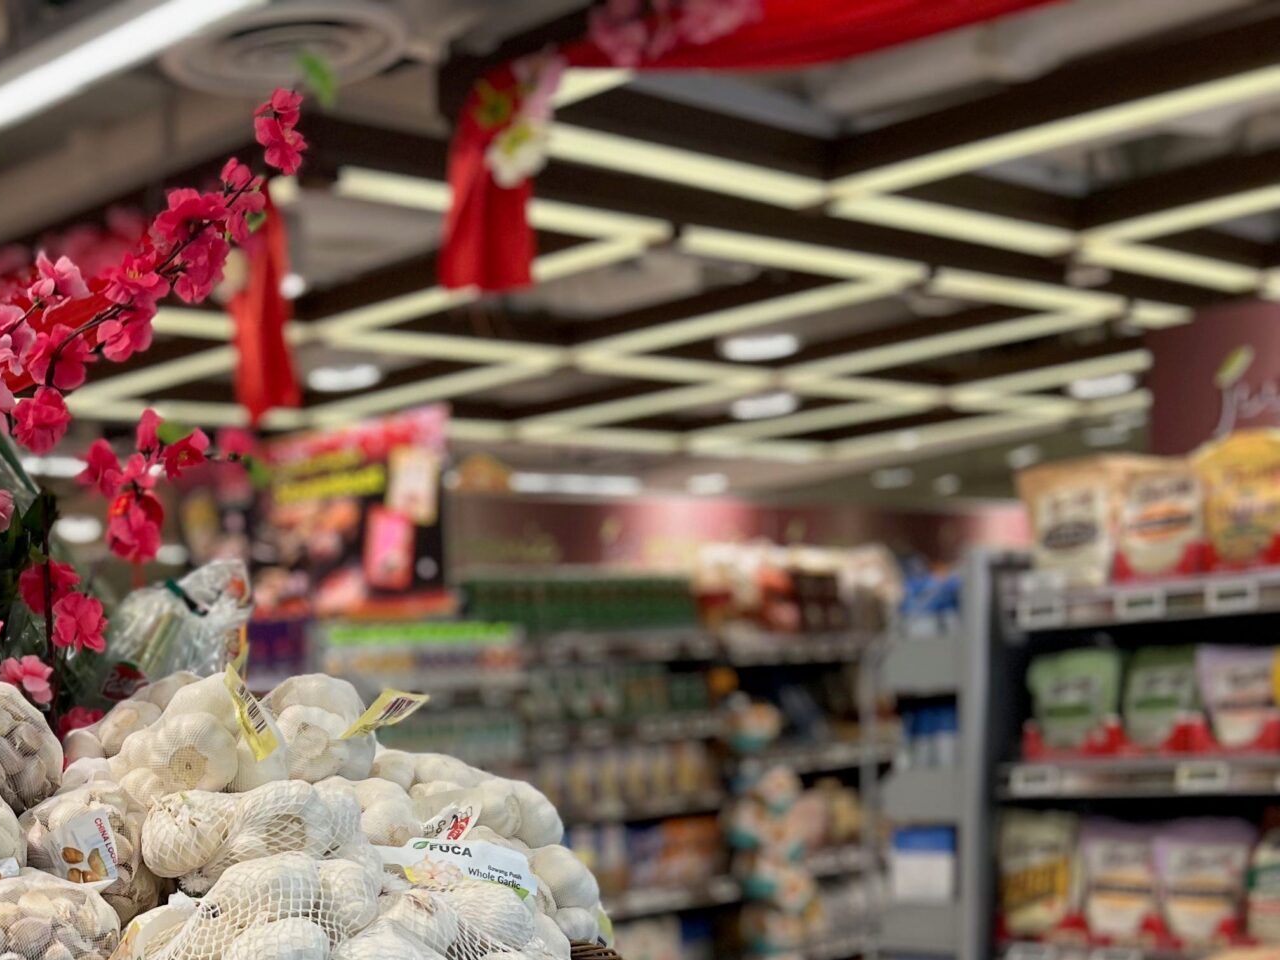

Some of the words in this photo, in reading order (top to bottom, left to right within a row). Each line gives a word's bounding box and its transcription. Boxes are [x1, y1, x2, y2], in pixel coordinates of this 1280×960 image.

[94, 817, 110, 843] CHINA
[429, 843, 473, 858] FUCA
[468, 867, 496, 882] Whole
[497, 875, 521, 890] Garlic
